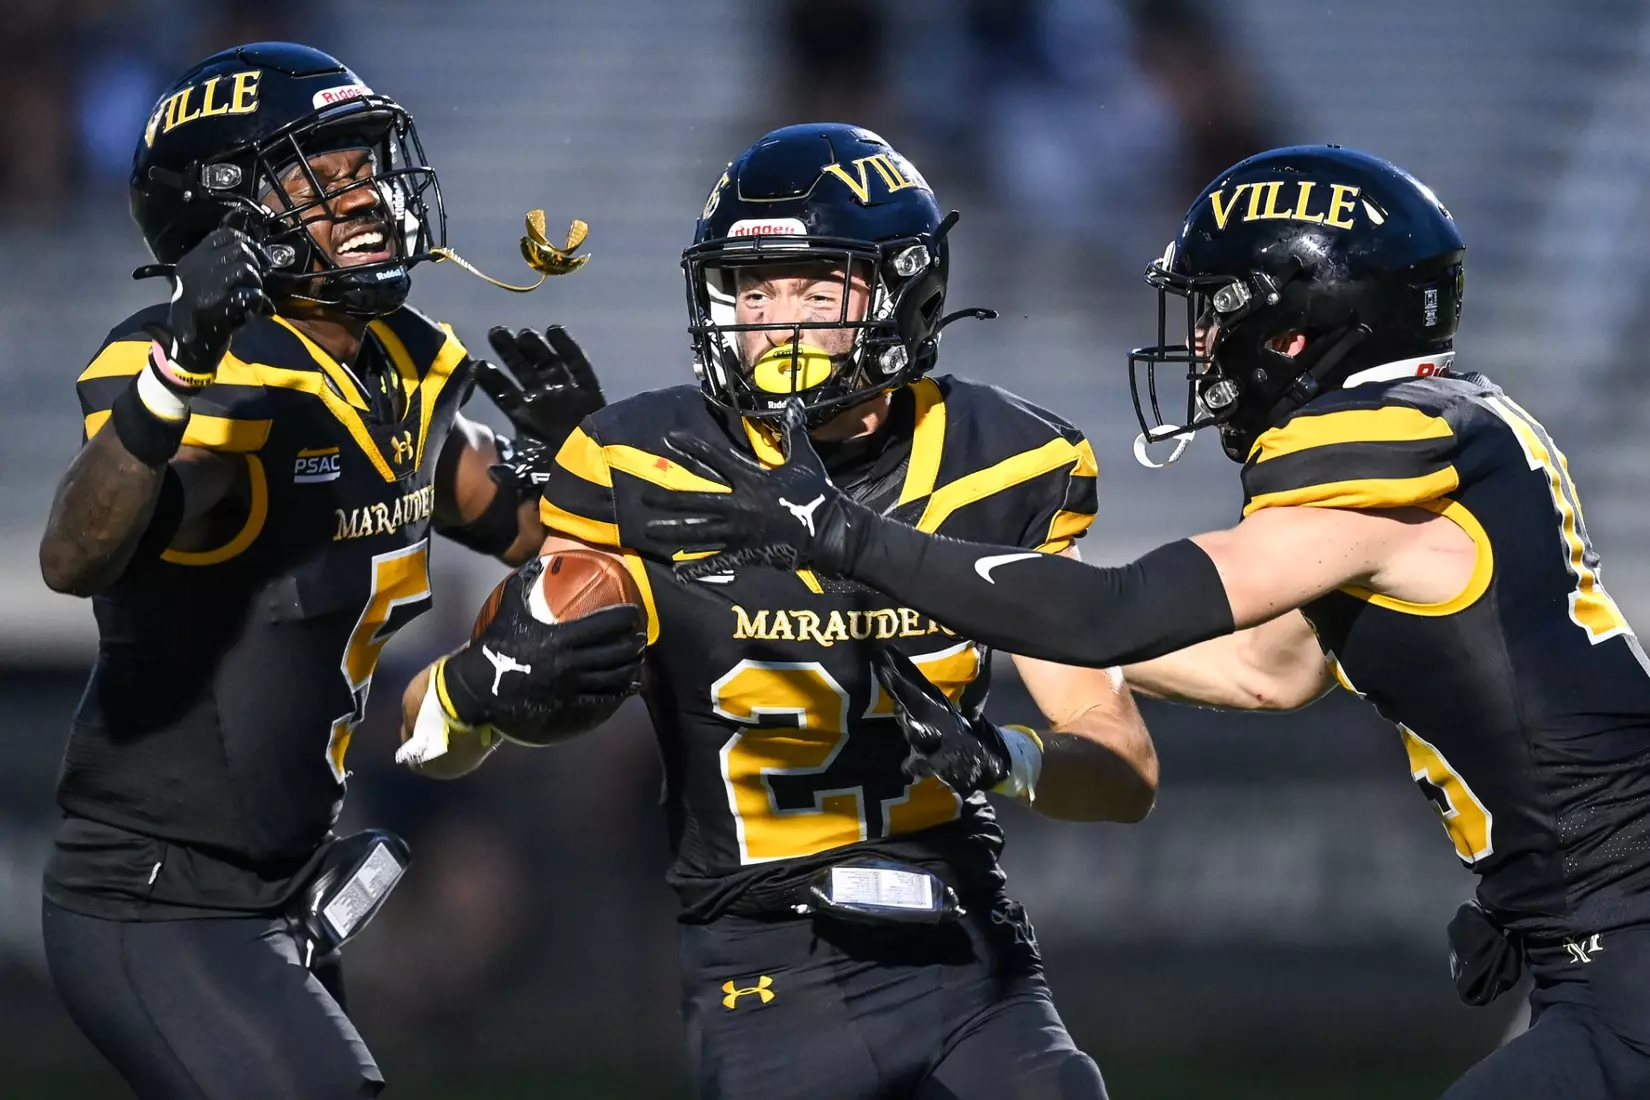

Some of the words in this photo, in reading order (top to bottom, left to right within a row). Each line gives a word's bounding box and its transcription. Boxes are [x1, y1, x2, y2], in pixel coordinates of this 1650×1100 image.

[822, 153, 918, 204] VIL
[1209, 181, 1359, 230] VILLE
[767, 400, 788, 409] Ridd
[295, 454, 340, 474] PSAC
[333, 484, 435, 541] MARAUDE
[733, 605, 957, 647] MARAUDE
